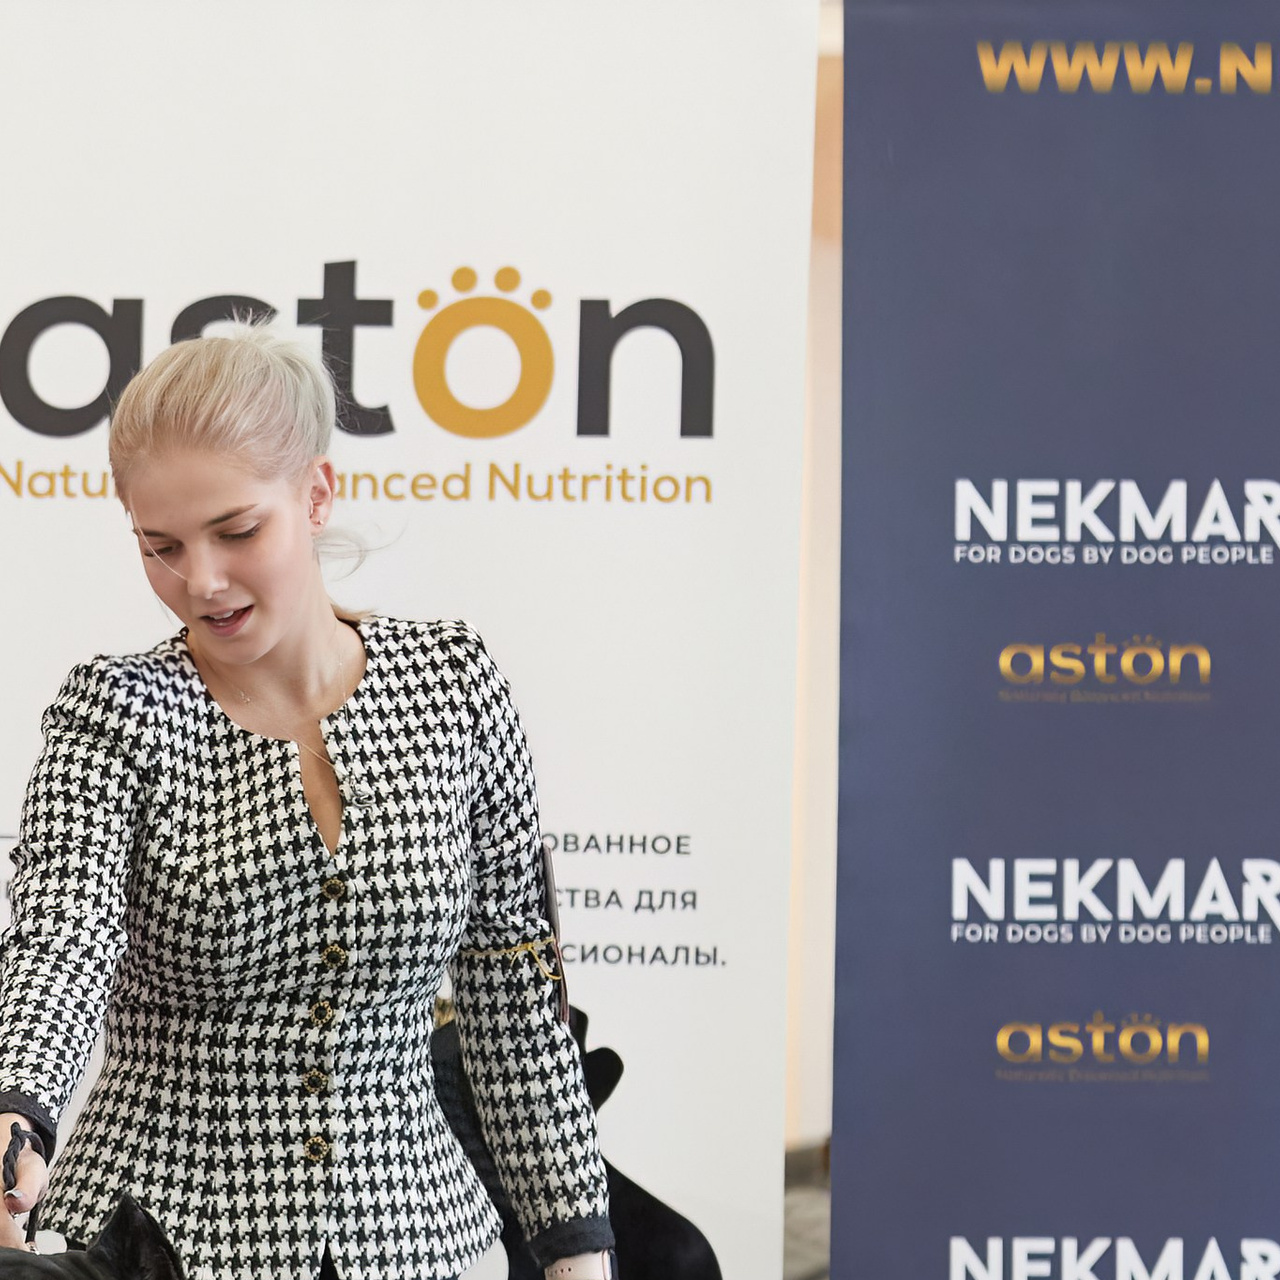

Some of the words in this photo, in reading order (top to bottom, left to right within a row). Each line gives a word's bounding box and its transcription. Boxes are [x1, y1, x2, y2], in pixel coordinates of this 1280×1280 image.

[488, 462, 713, 504] Nutrition
[954, 478, 1280, 549] NEKMAR
[954, 545, 1002, 564] FOR
[1009, 545, 1076, 564] DOGS
[1083, 546, 1113, 564] BY
[1121, 545, 1174, 565] DOG
[1181, 546, 1274, 565] PEOPLE
[542, 833, 692, 855] ОВАННОЕ
[556, 888, 623, 909] ТВА
[634, 889, 697, 914] ДЛЯ
[950, 857, 1280, 933] NEKMAR
[951, 924, 999, 943] FOR
[1007, 924, 1074, 943] DOGS
[1081, 924, 1112, 943] BY
[1119, 924, 1172, 944] DOG
[1180, 924, 1272, 944] PEOPLE
[561, 944, 727, 967] СИОНАЛЫ.
